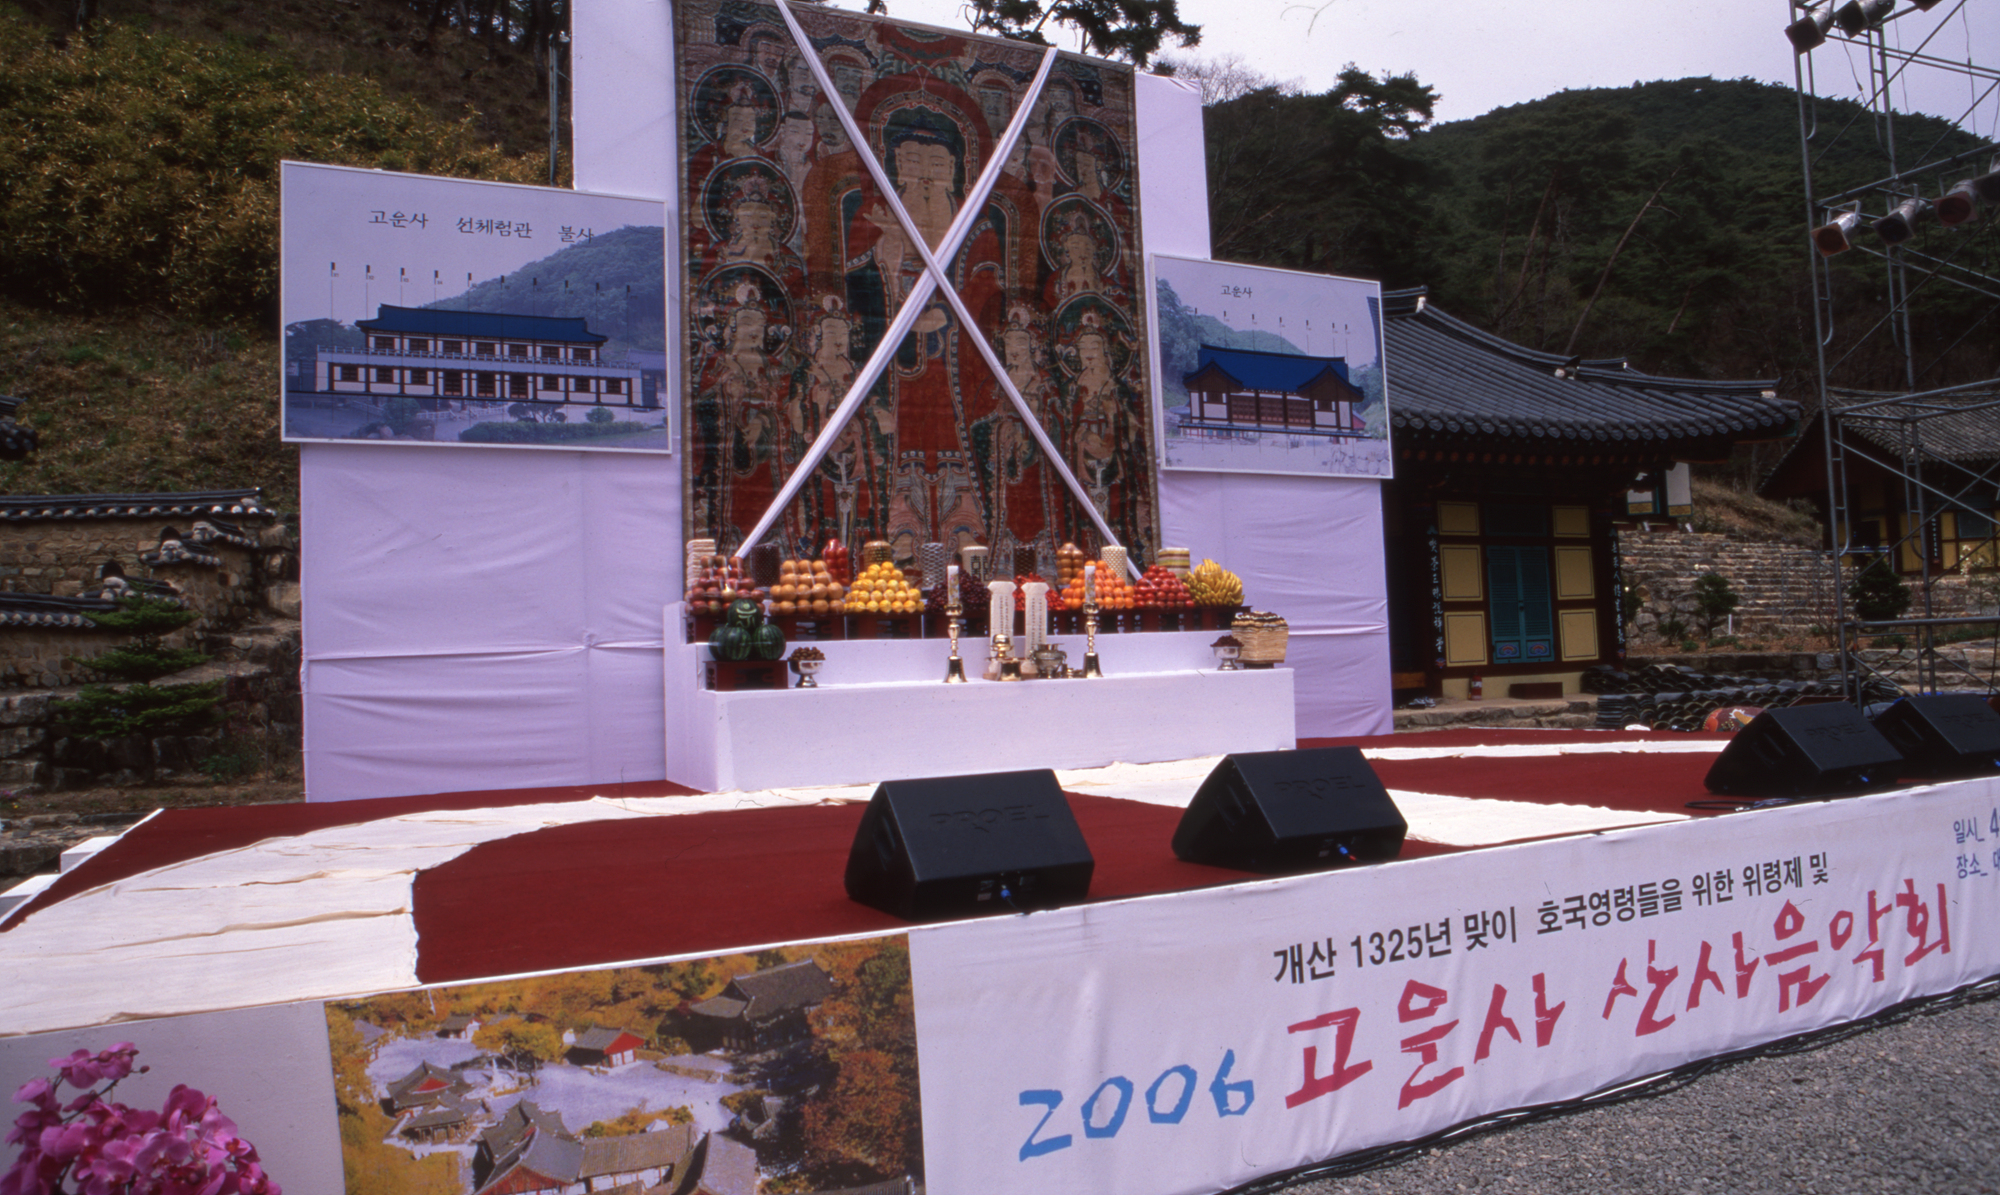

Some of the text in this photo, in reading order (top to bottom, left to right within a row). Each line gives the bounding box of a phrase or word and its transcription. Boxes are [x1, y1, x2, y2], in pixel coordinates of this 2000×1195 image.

[368, 210, 595, 244] 고운사 선체험관 불사
[1220, 285, 1253, 299] 고운사
[1273, 775, 1366, 800] PROEL
[929, 804, 1050, 833] PROEL
[1273, 851, 1830, 985] 개산 1325년 맞이 호국영령들을 위한 위령제 및
[1017, 878, 1951, 1164] 2006 고운사 산사음악회
